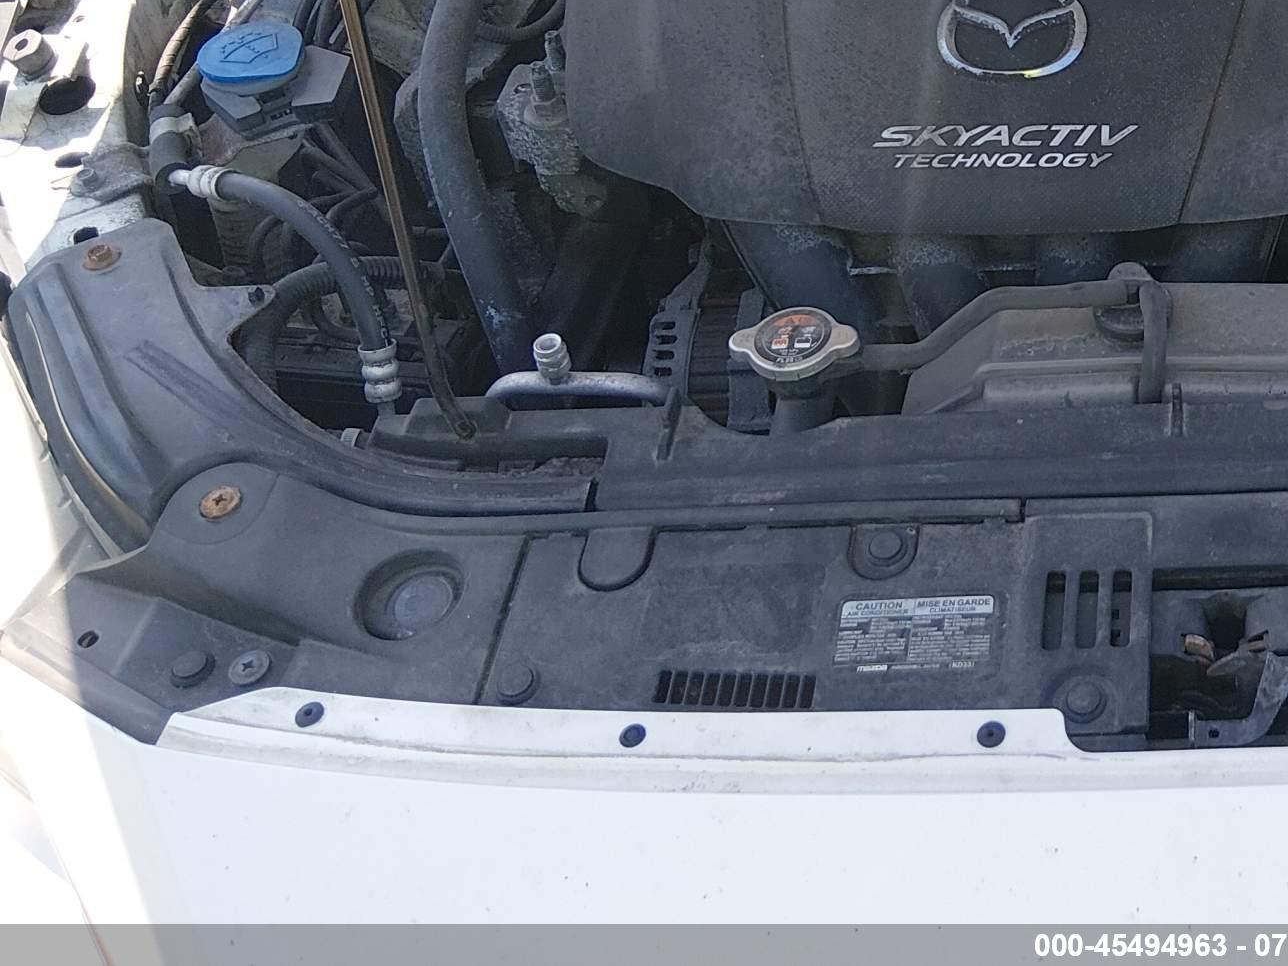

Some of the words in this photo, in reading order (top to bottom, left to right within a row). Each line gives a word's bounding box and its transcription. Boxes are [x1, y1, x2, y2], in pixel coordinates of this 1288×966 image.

[871, 124, 1139, 148] SKYACTIV
[894, 152, 1113, 169] TECHNOLOGY
[856, 601, 903, 611] CAUTION
[917, 600, 940, 608] MISE
[942, 599, 956, 607] EN
[957, 598, 991, 606] GARDE
